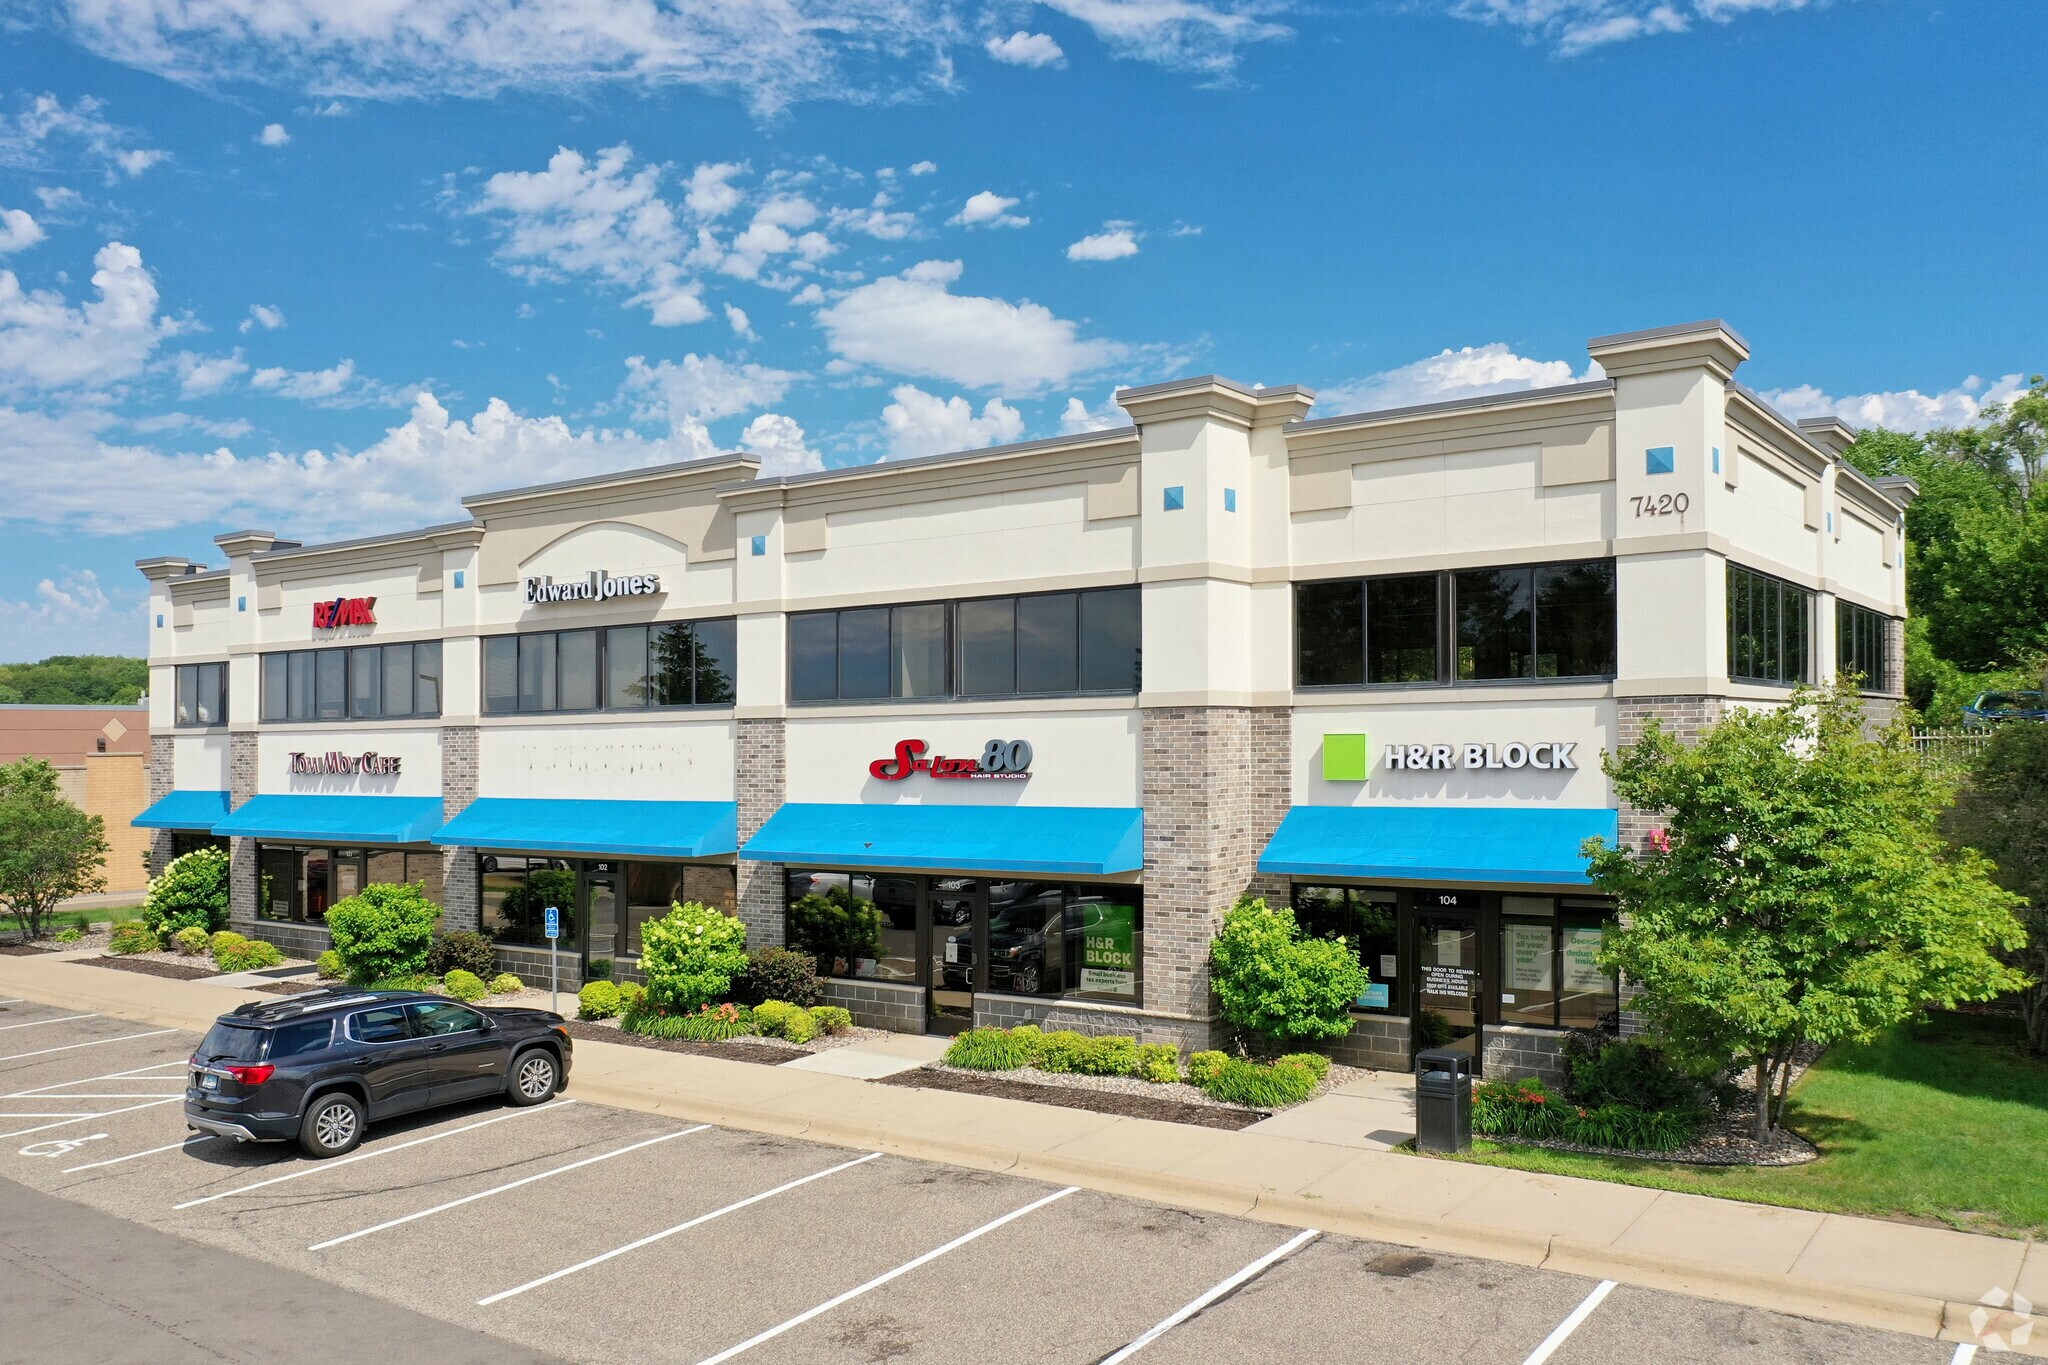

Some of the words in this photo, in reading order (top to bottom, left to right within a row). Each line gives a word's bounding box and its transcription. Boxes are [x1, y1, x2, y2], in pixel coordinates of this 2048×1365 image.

[1629, 492, 1690, 517] 7420
[523, 571, 597, 604] Edward
[595, 569, 661, 602] Jones
[313, 597, 377, 628] RE/MAX
[869, 739, 981, 781] Salon
[980, 739, 1033, 772] 80
[1385, 744, 1455, 770] H&R
[1464, 742, 1578, 770] BLOCK
[598, 863, 608, 871] 102
[948, 881, 961, 889] 103
[1439, 895, 1457, 905] 104
[1086, 936, 1114, 950] H&R
[1531, 933, 1548, 941] help
[1086, 950, 1132, 965] BLOCK
